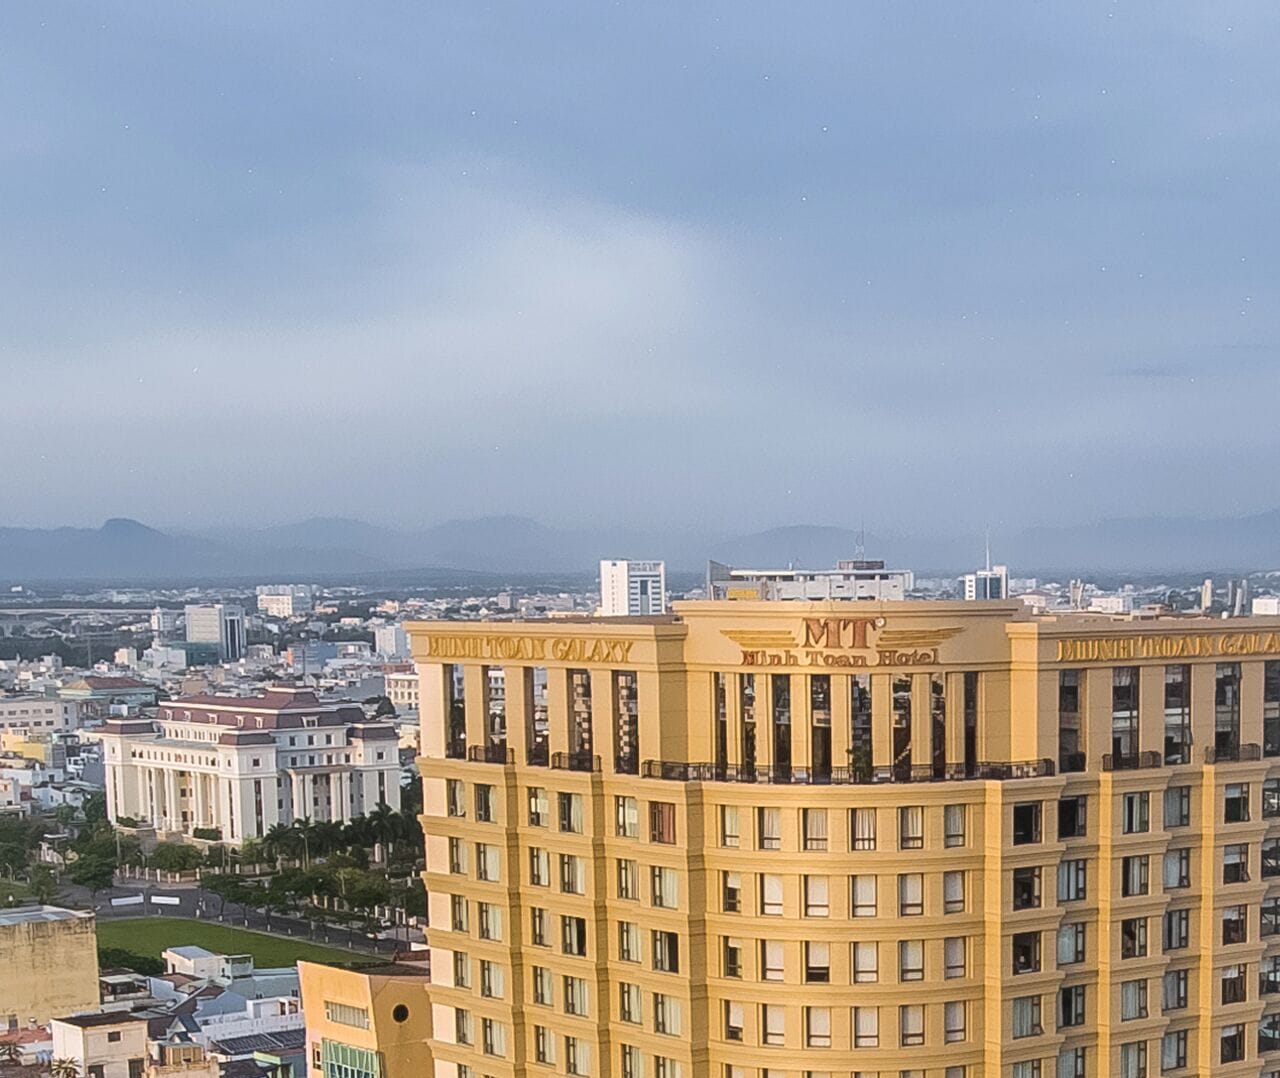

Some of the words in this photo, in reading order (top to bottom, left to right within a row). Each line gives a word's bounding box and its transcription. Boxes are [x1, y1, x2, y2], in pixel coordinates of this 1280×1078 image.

[801, 617, 877, 649] MT
[487, 636, 547, 660] TOAN
[552, 638, 634, 662] GALAXY
[741, 650, 799, 666] Minh
[805, 650, 868, 667] Toan
[876, 648, 941, 666] Hotel
